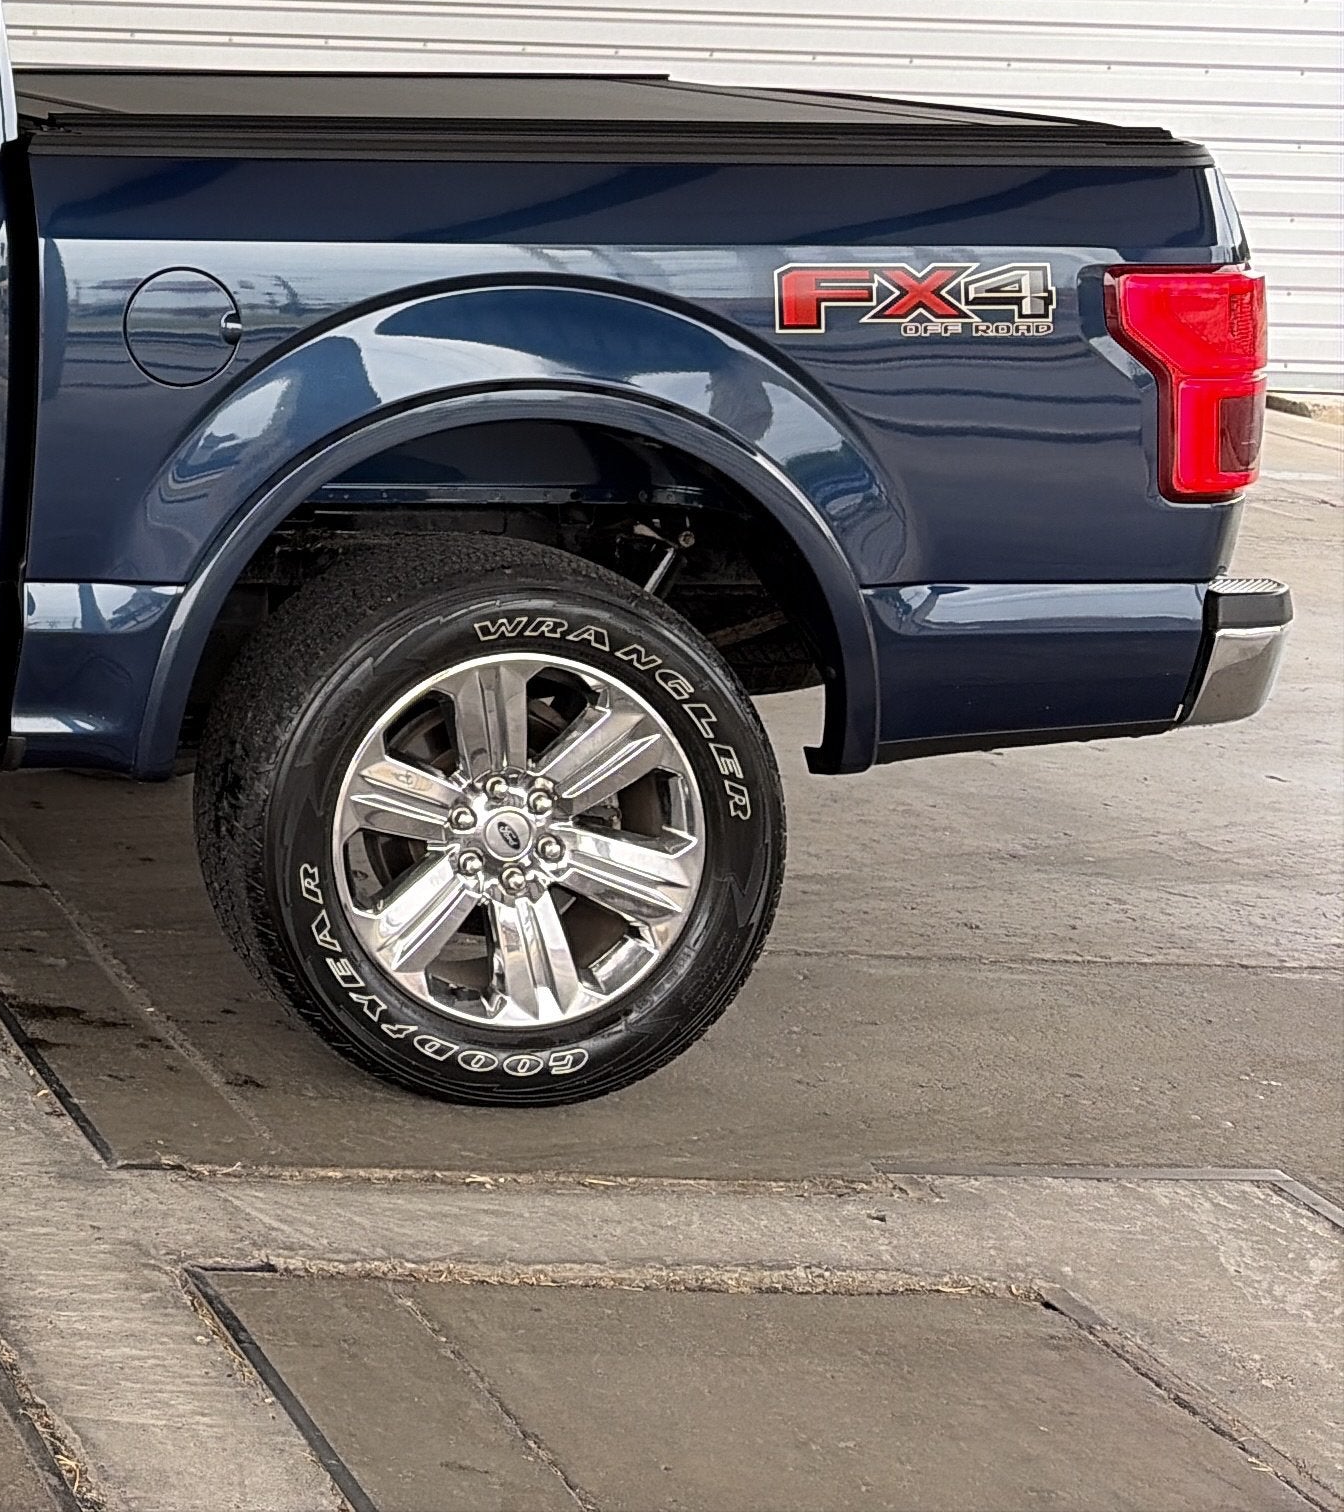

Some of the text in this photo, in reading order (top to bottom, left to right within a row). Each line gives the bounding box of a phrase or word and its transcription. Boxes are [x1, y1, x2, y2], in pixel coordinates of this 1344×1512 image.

[773, 262, 1057, 334] FX4
[900, 322, 1055, 337] OFF ROAD
[473, 615, 753, 822] WRANGLER
[299, 863, 589, 1077] GOODYEAR
